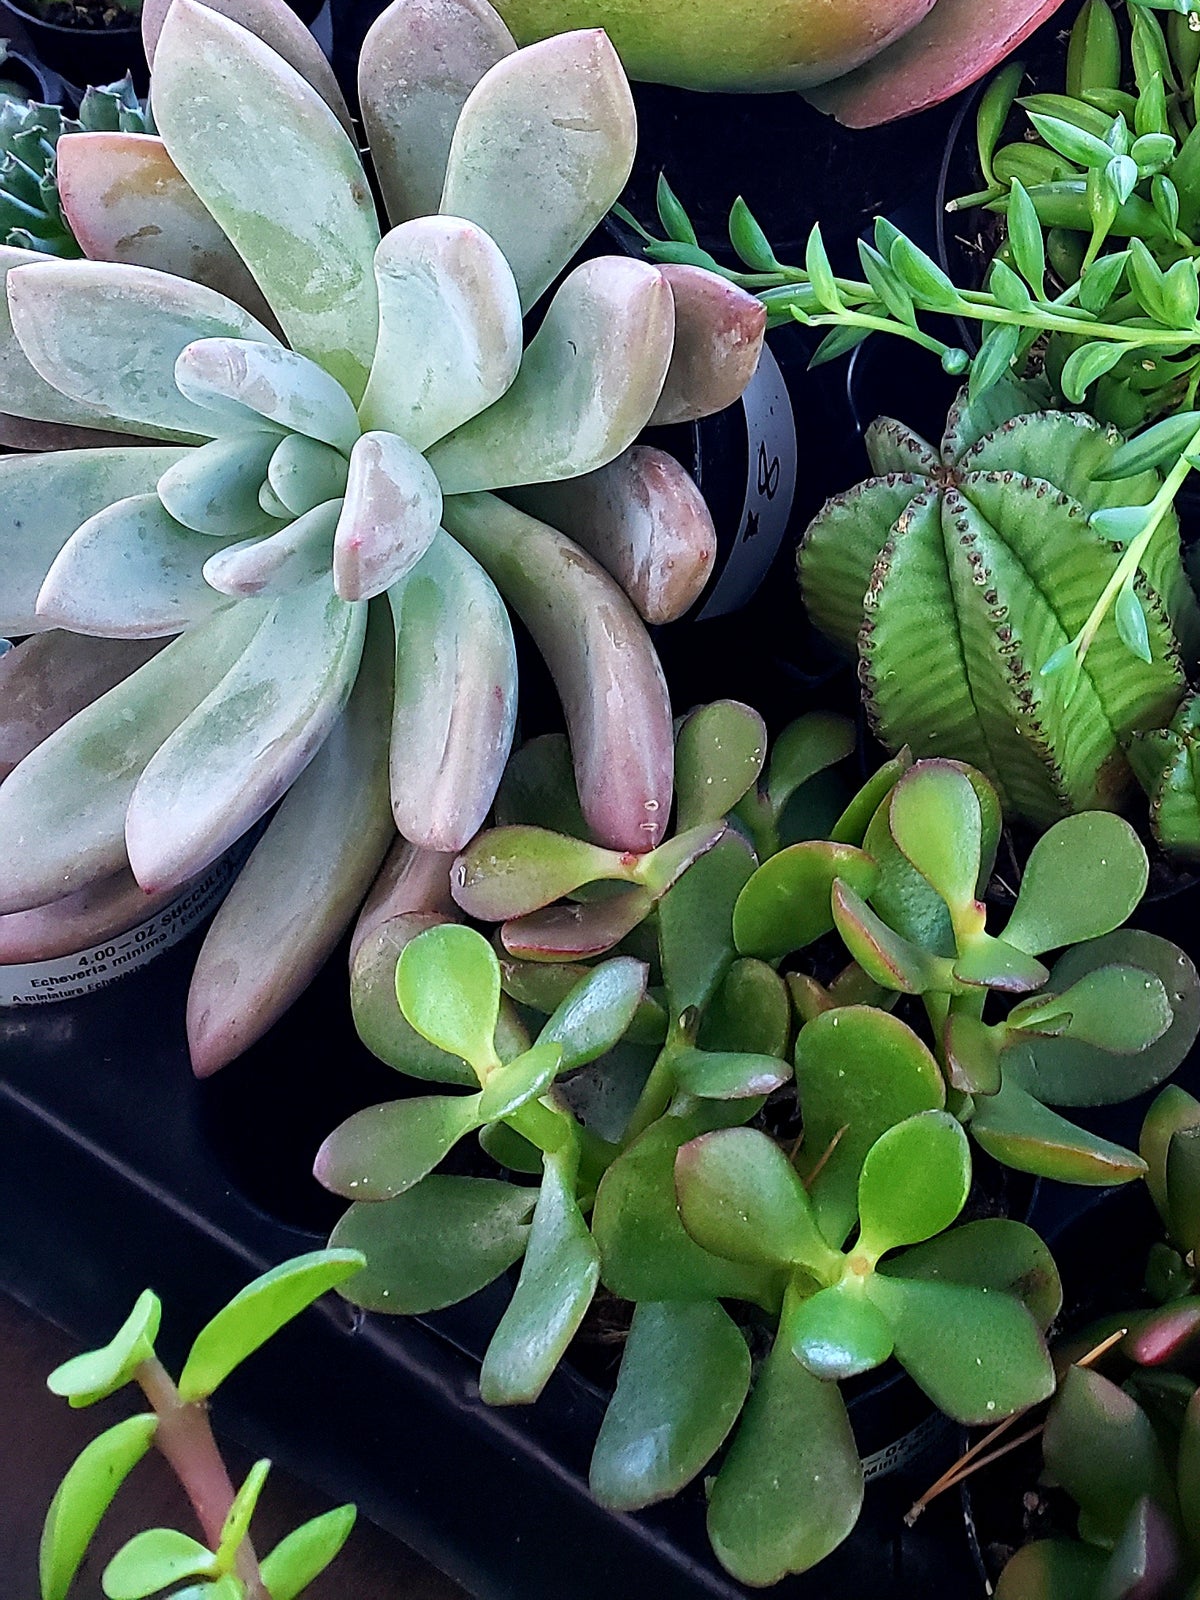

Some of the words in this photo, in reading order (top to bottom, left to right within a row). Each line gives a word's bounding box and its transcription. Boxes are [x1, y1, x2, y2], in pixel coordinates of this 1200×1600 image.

[31, 963, 107, 988] Echeveria
[112, 933, 168, 967] minima
[79, 946, 116, 967] 4.00
[135, 924, 157, 943] OZ
